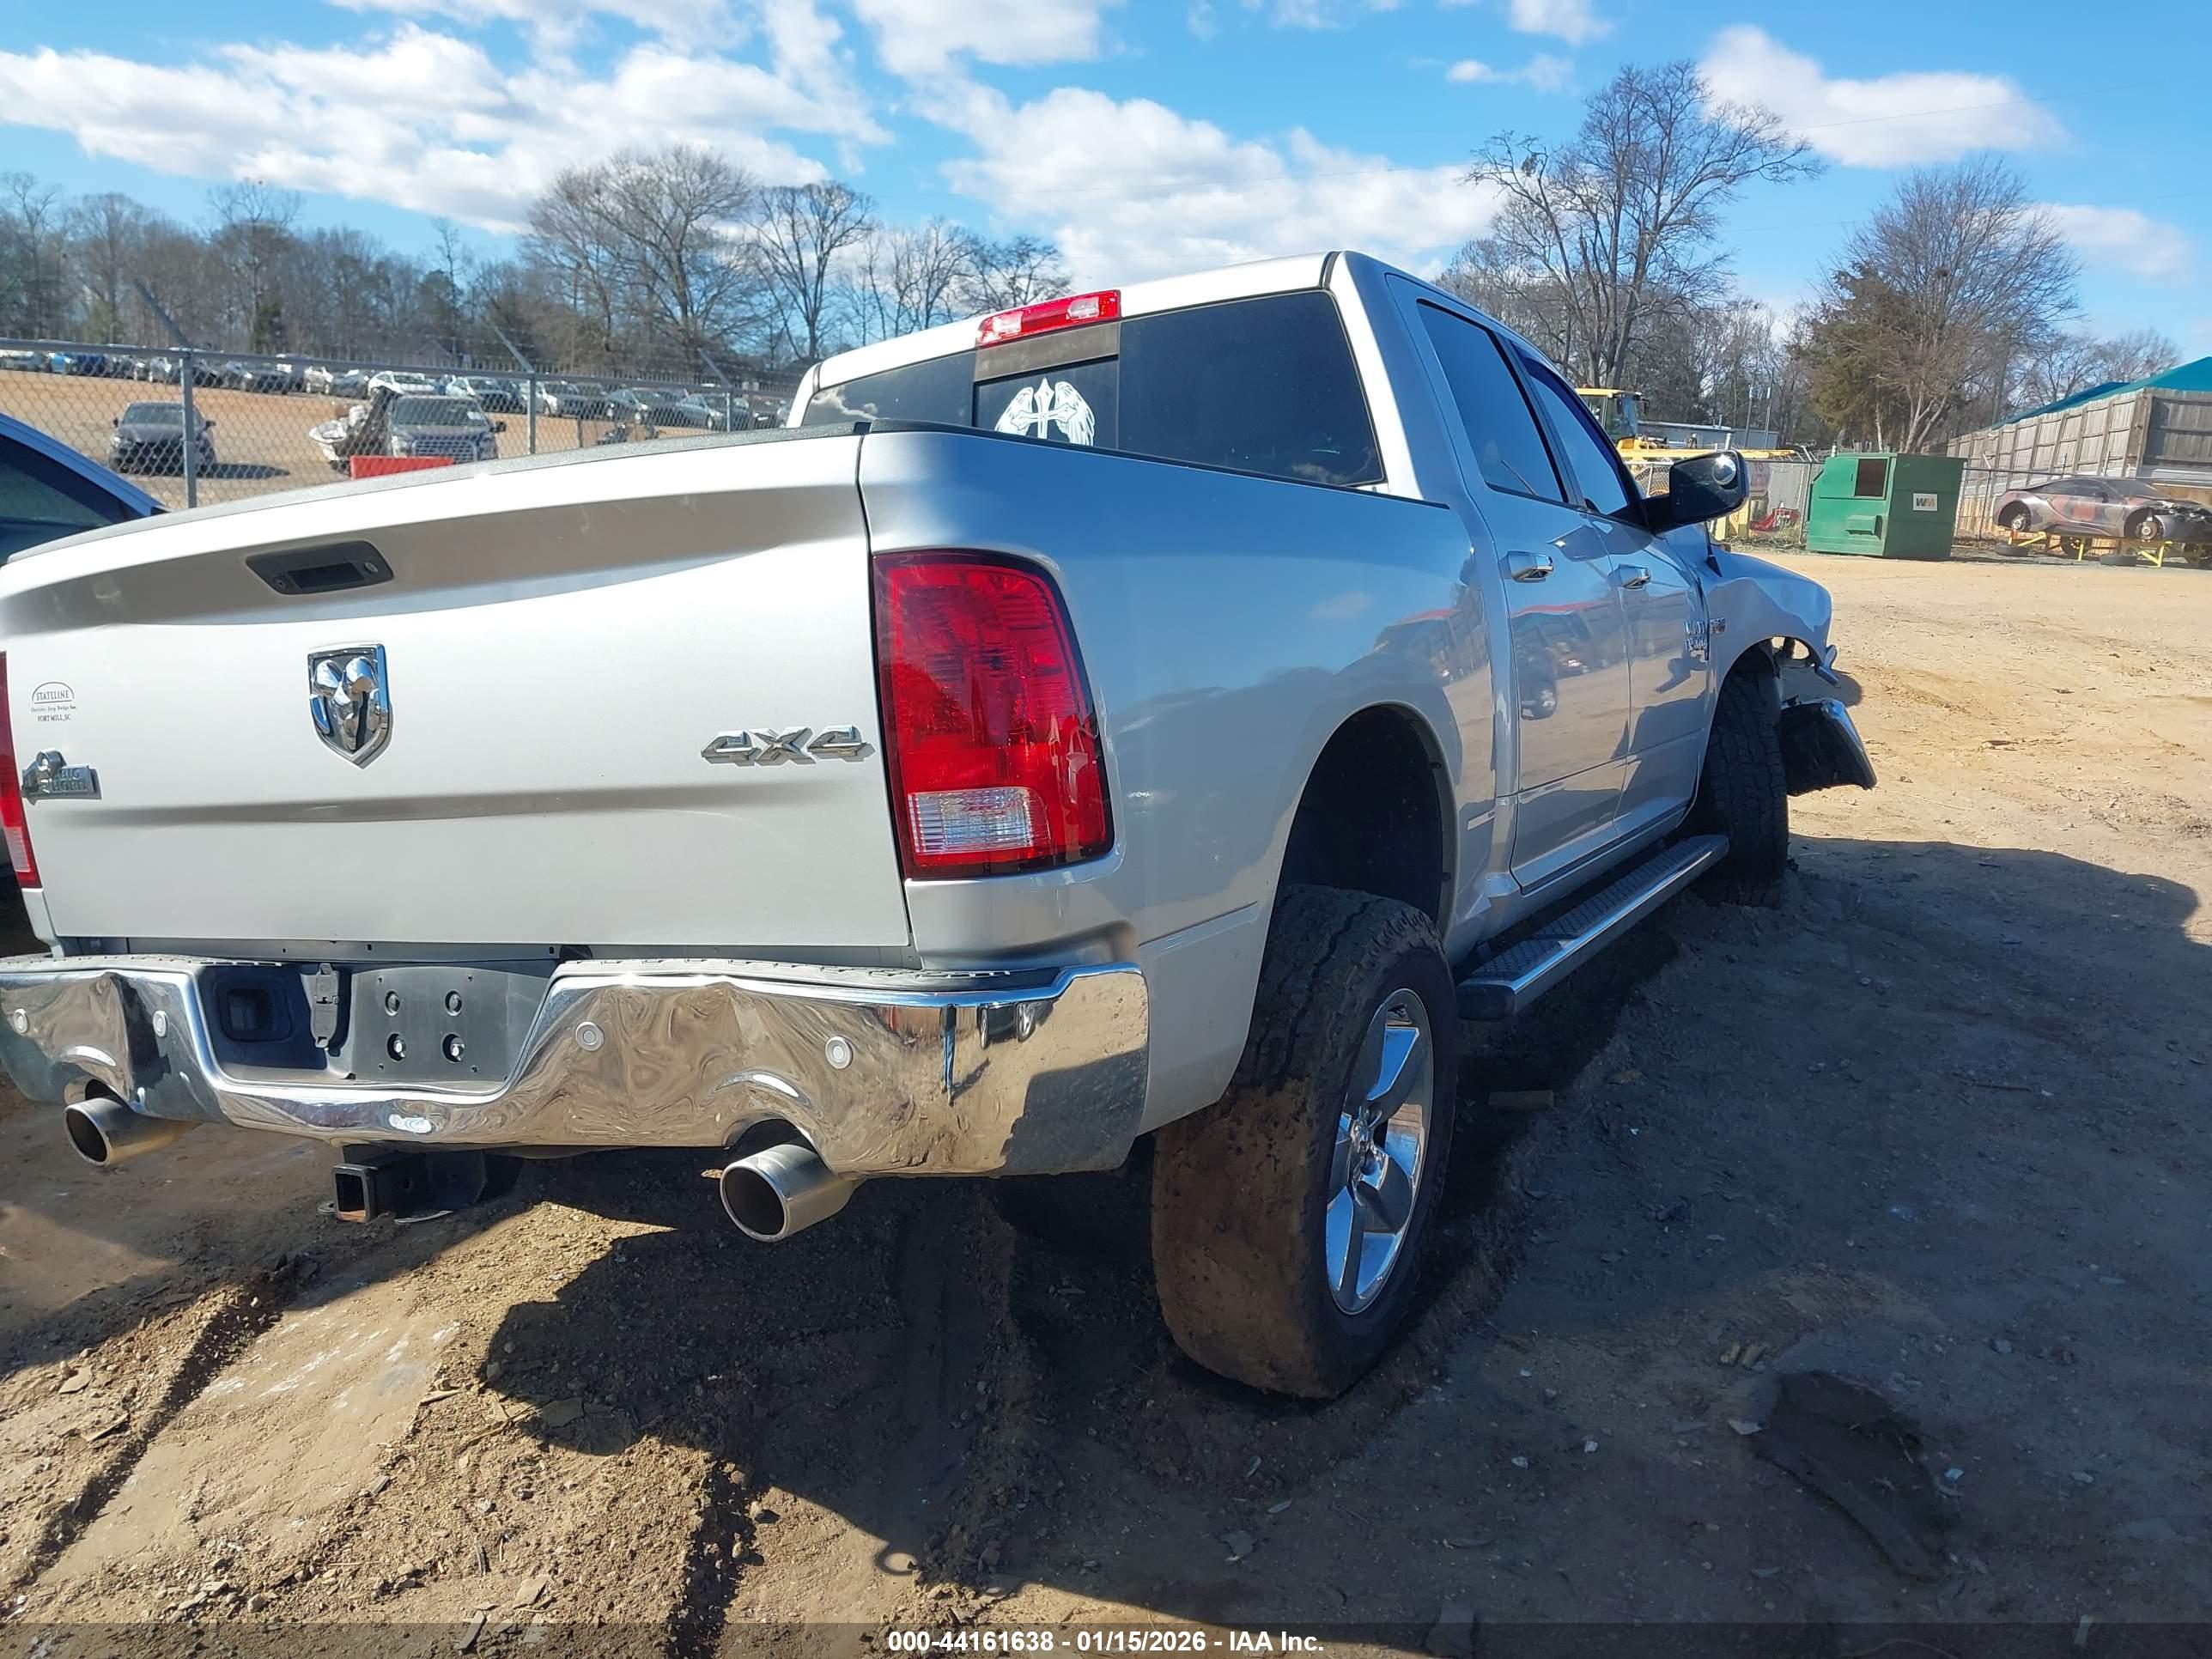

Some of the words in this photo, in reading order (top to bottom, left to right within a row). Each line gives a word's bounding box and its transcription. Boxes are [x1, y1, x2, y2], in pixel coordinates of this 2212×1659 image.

[1916, 497, 1935, 507] WM
[36, 690, 69, 701] STATELINE
[59, 769, 80, 780] BIG
